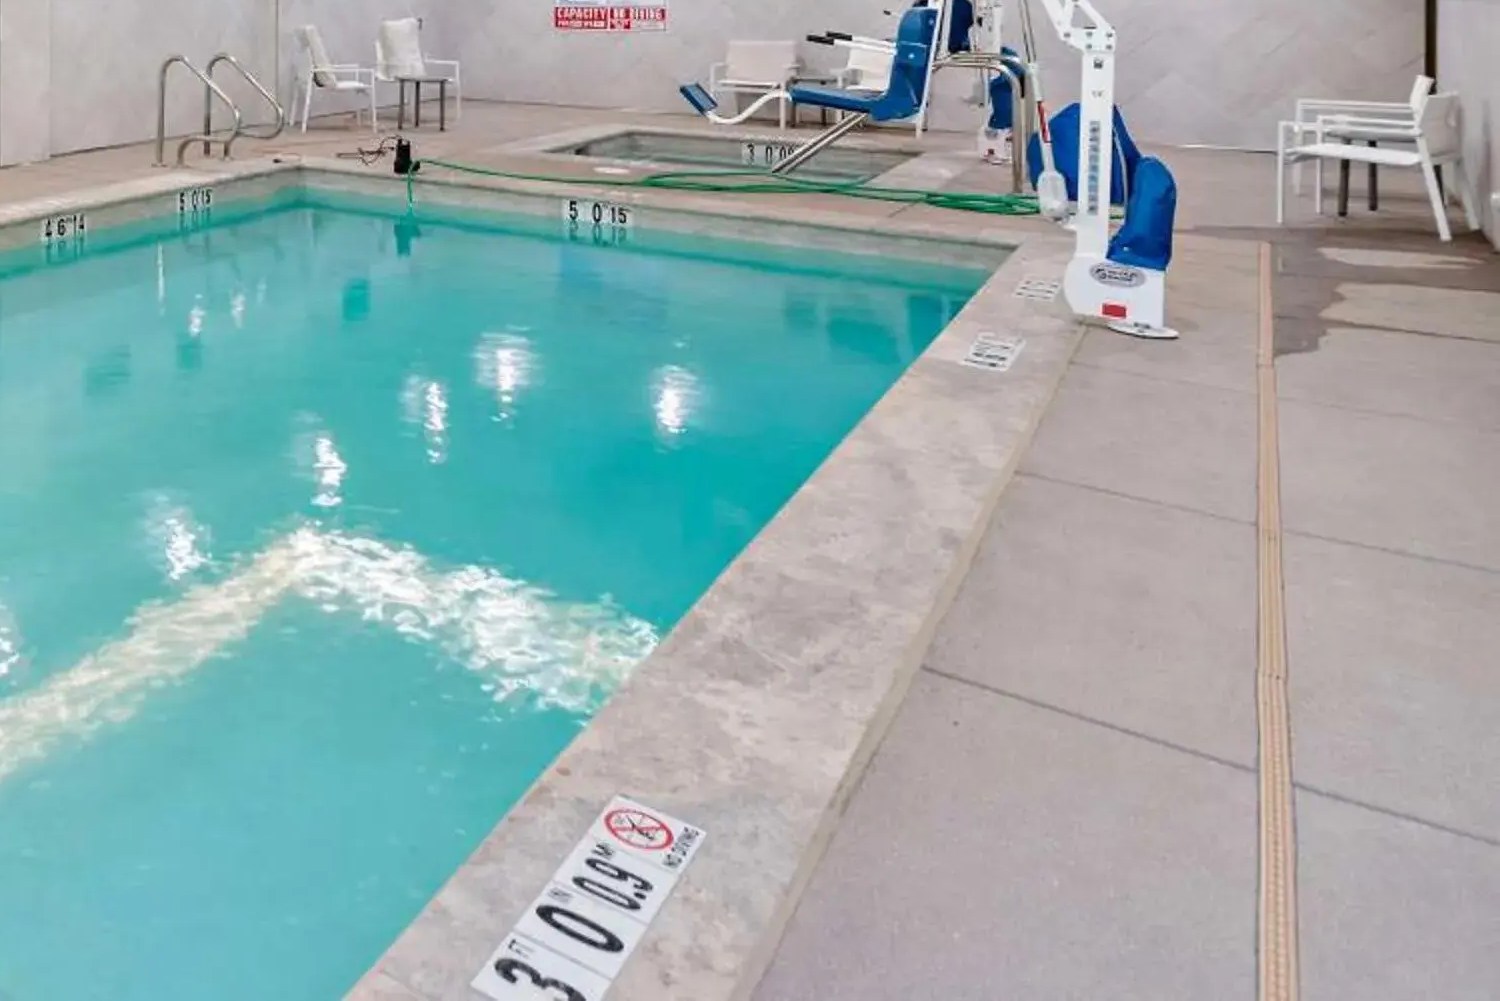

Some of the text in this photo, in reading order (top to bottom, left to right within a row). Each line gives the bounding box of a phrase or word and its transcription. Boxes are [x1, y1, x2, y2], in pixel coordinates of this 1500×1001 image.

[557, 7, 606, 19] CAPACITY
[569, 200, 579, 221] 5
[592, 202, 602, 223] 0
[535, 904, 625, 953] 0
[494, 958, 587, 1001] 3
